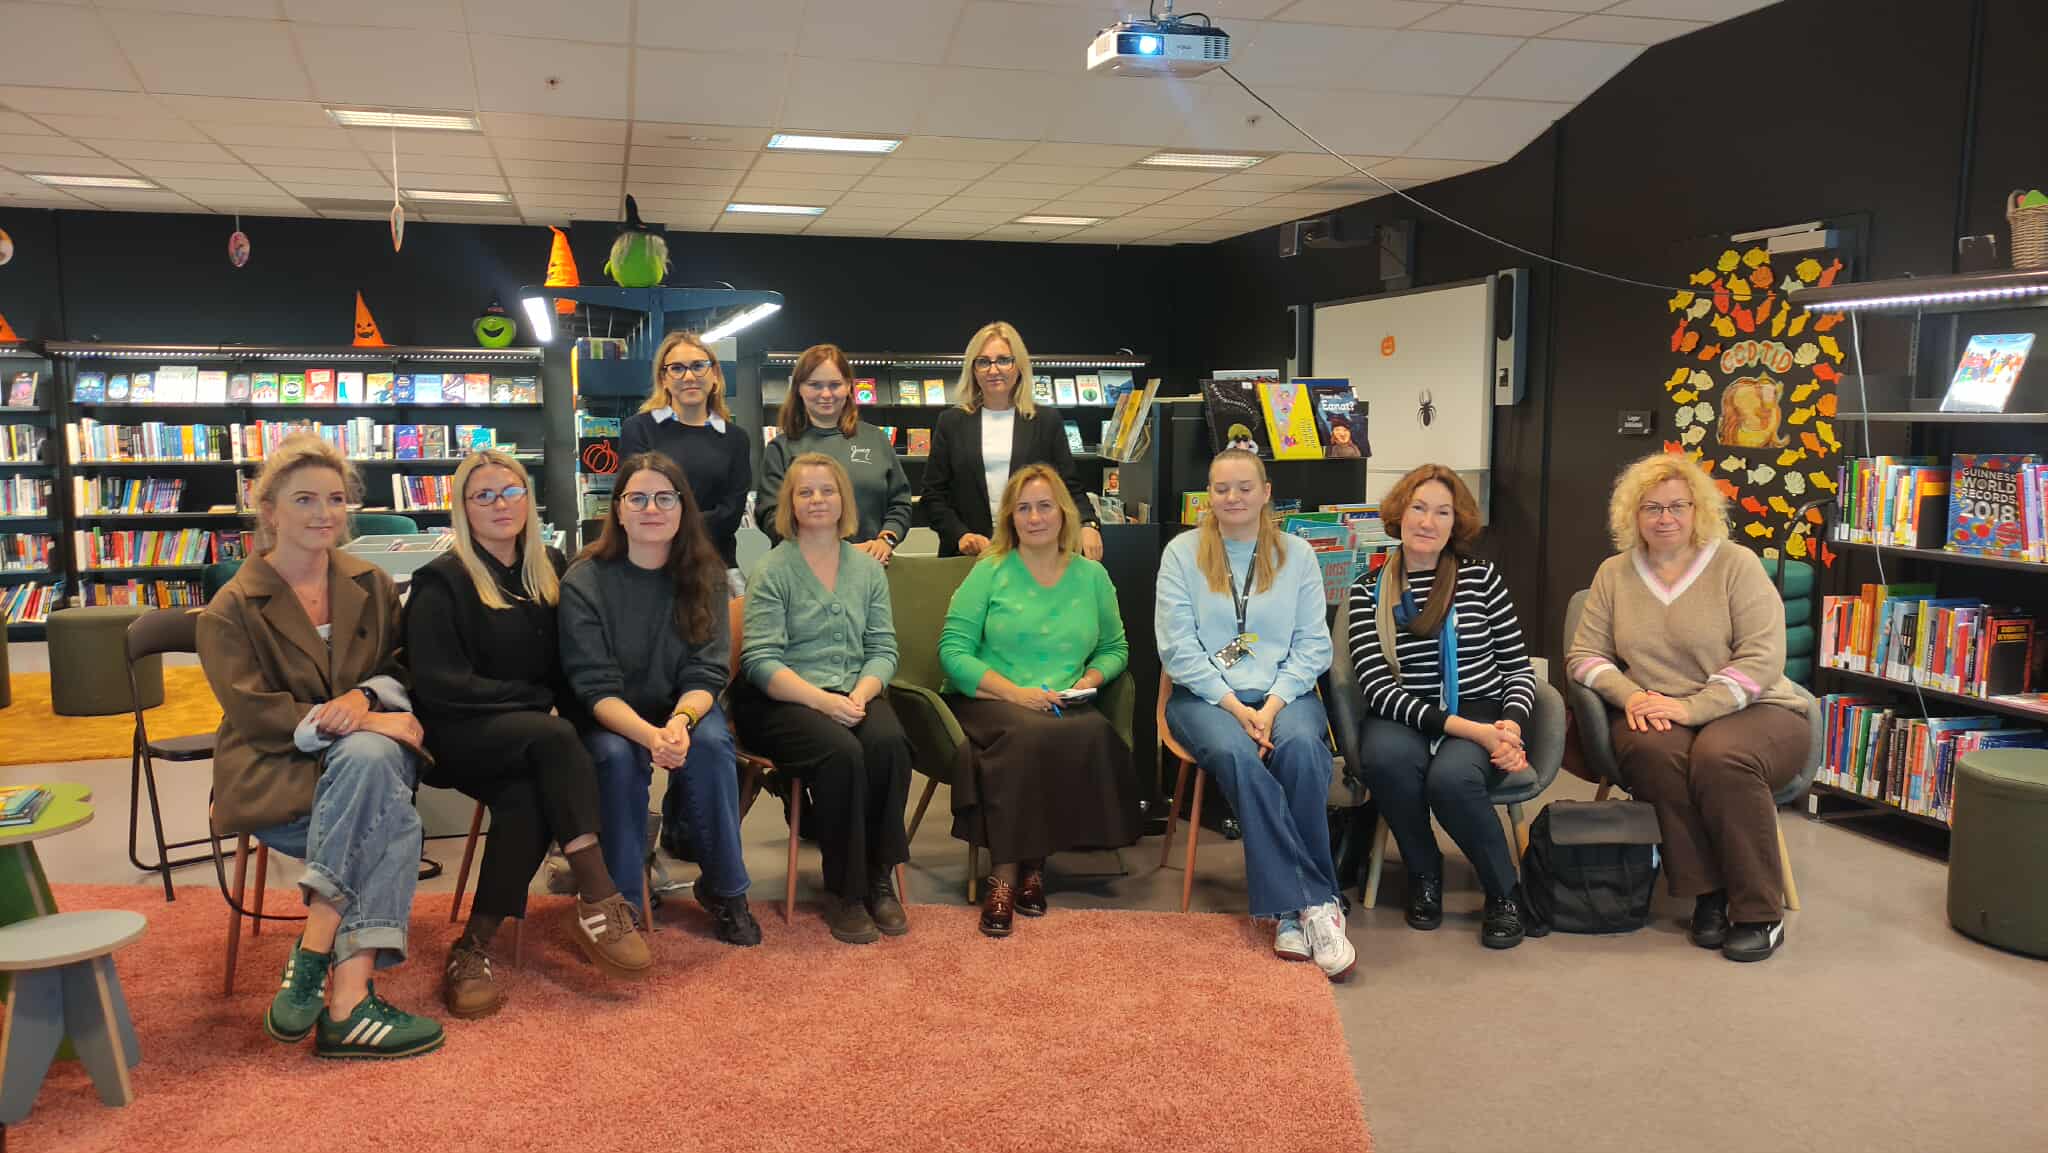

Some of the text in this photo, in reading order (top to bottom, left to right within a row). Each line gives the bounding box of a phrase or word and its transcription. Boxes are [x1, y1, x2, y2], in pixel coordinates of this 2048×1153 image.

[1961, 467, 2016, 483] GUINNESS
[1961, 476, 2017, 494] WORLD
[1961, 487, 2016, 505] RECORDS
[1959, 499, 2016, 523] 2018
